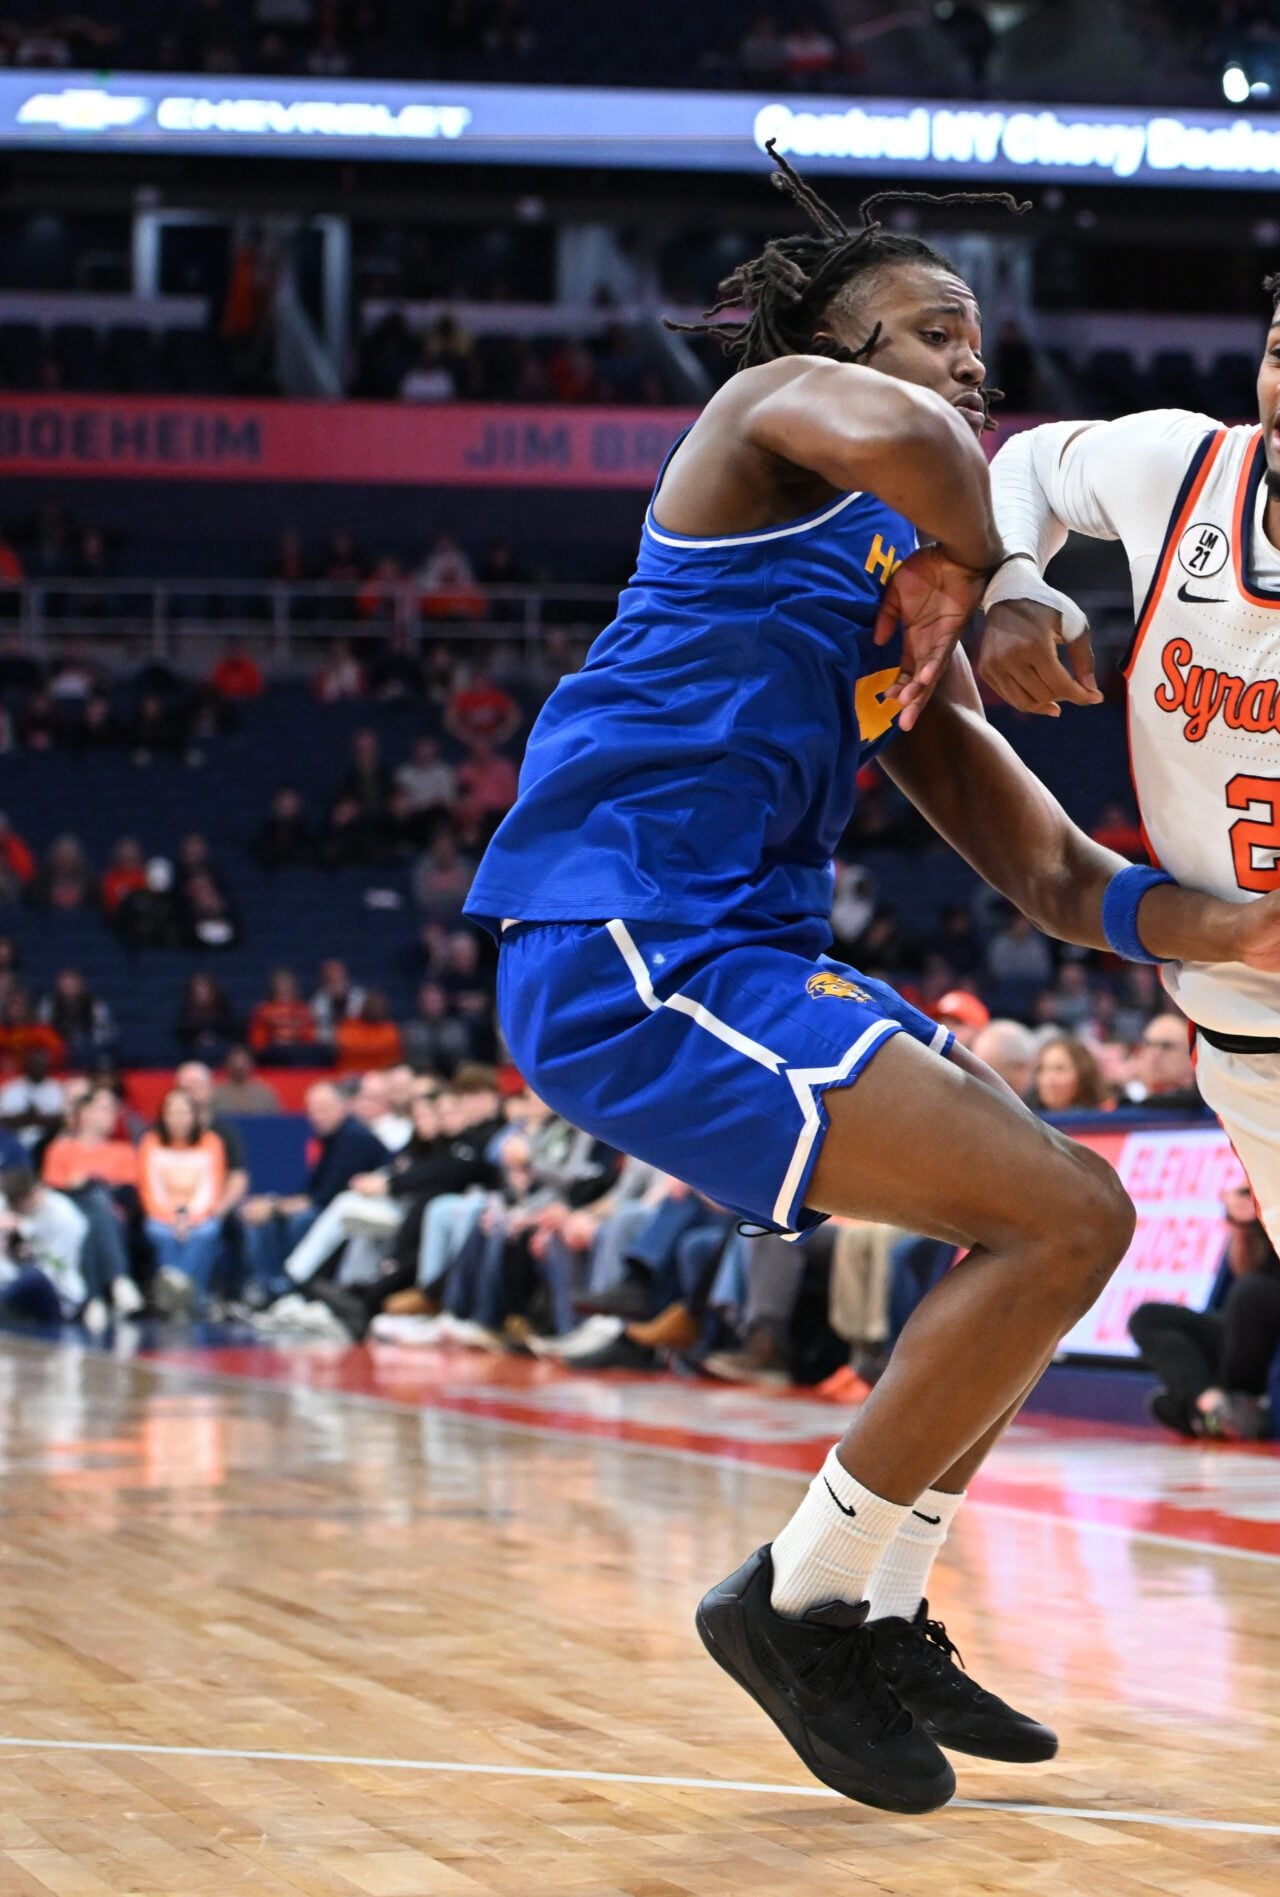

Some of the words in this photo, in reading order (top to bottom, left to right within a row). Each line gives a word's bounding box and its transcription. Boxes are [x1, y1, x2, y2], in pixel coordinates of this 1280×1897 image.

[157, 98, 471, 138] CHEVROLET
[754, 104, 928, 159] Central
[931, 111, 1003, 162] NY
[1003, 112, 1146, 177] Chevy
[463, 420, 571, 470] JIM
[1188, 546, 1212, 572] 21
[1199, 529, 1219, 550] LM
